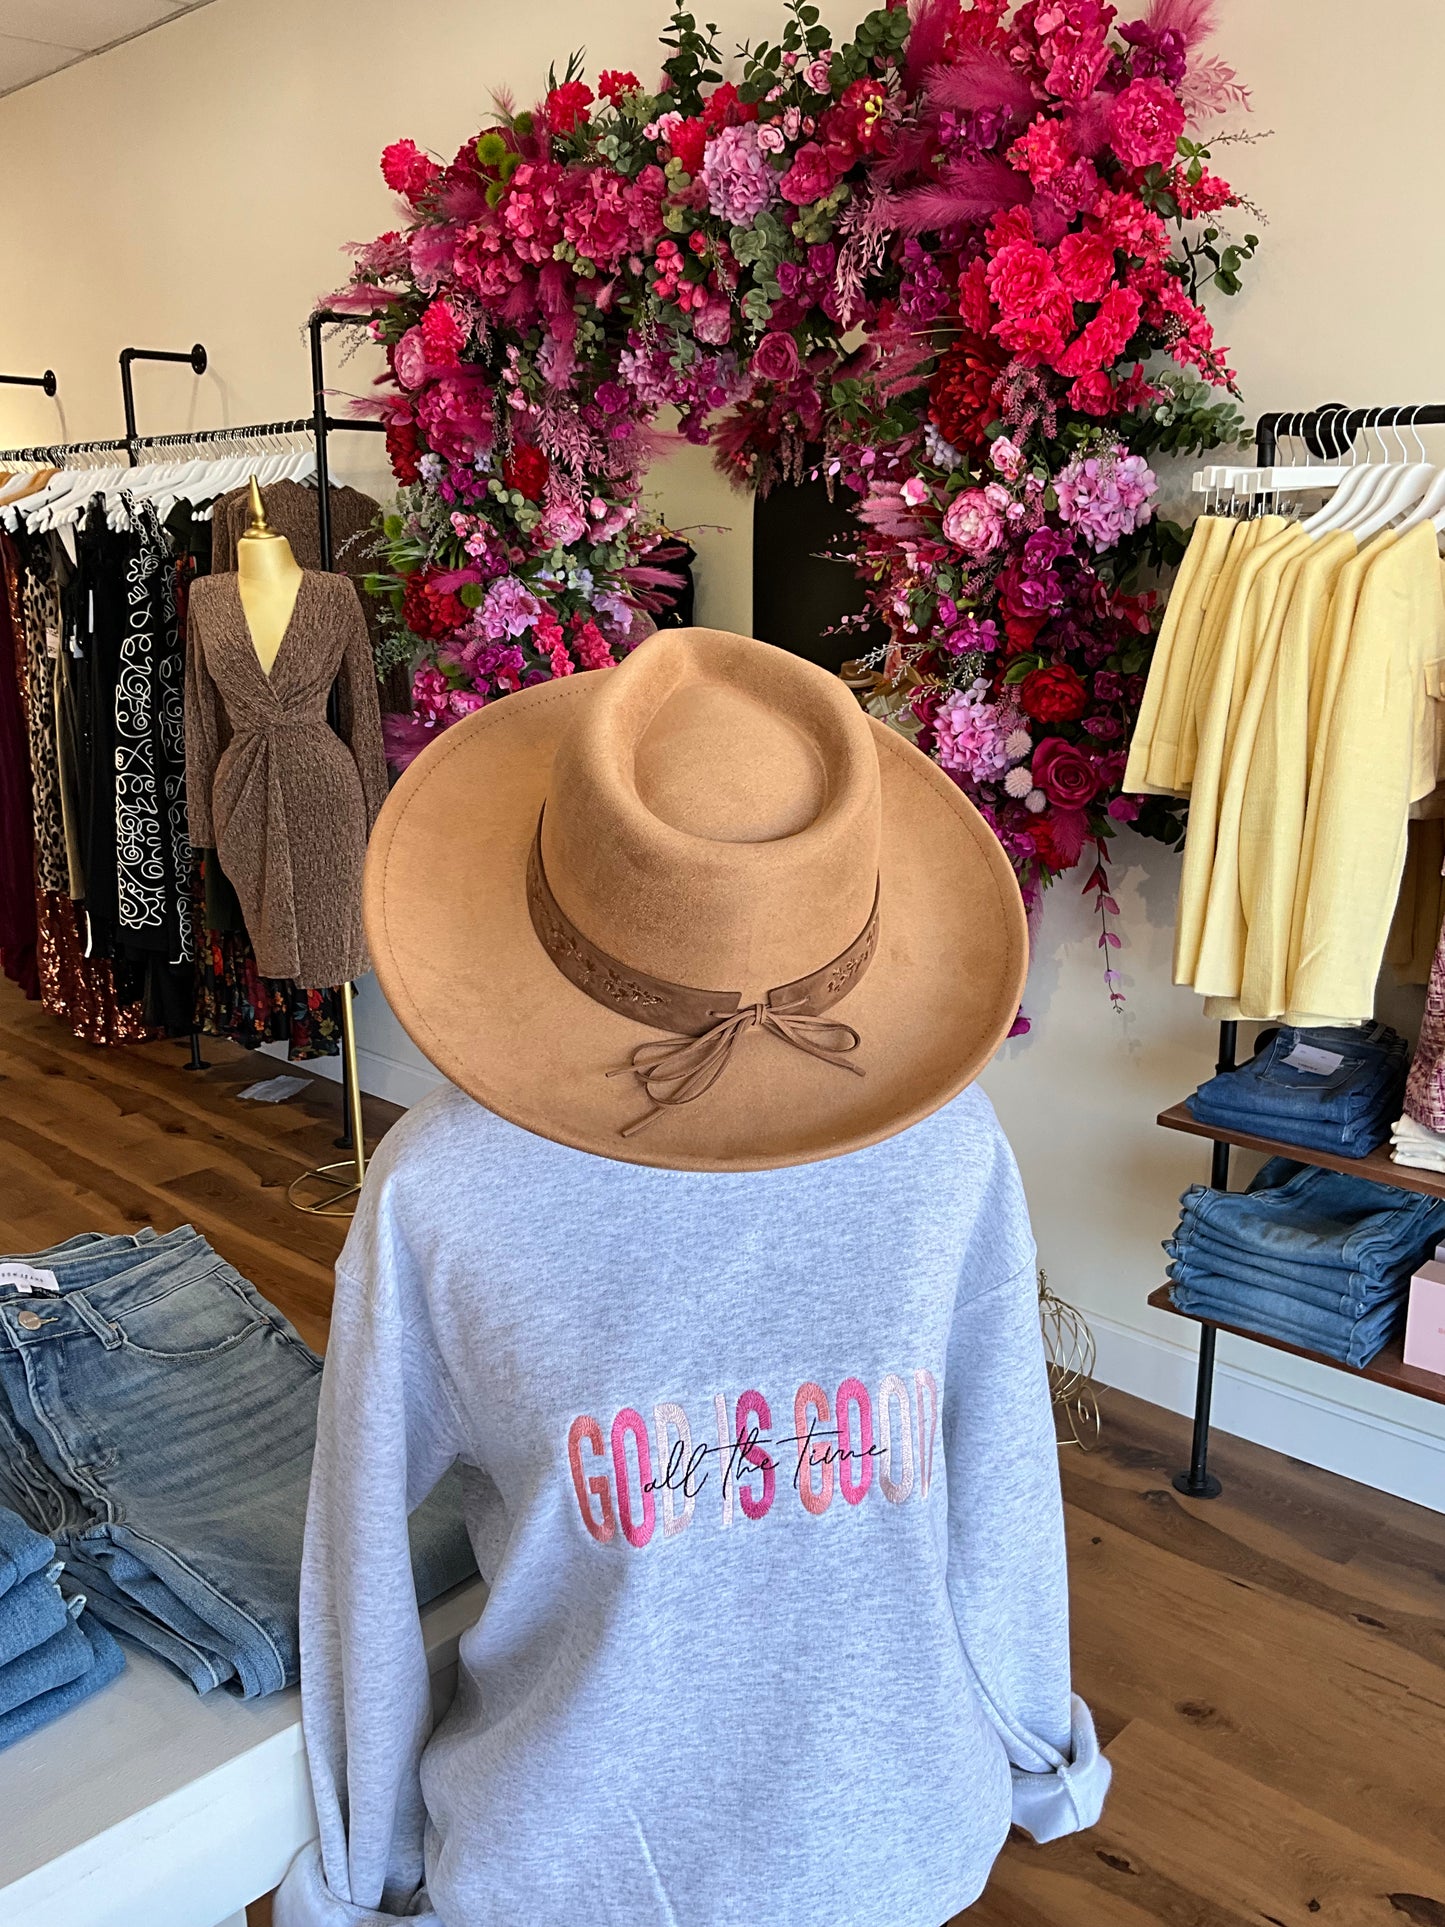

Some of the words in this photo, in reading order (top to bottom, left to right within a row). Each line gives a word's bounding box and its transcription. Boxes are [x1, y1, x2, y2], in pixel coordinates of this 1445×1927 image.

[568, 1402, 696, 1548] GOD
[714, 1389, 776, 1526] IS
[794, 1367, 938, 1516] GOOD
[644, 1440, 709, 1498] all
[703, 1426, 780, 1500] the
